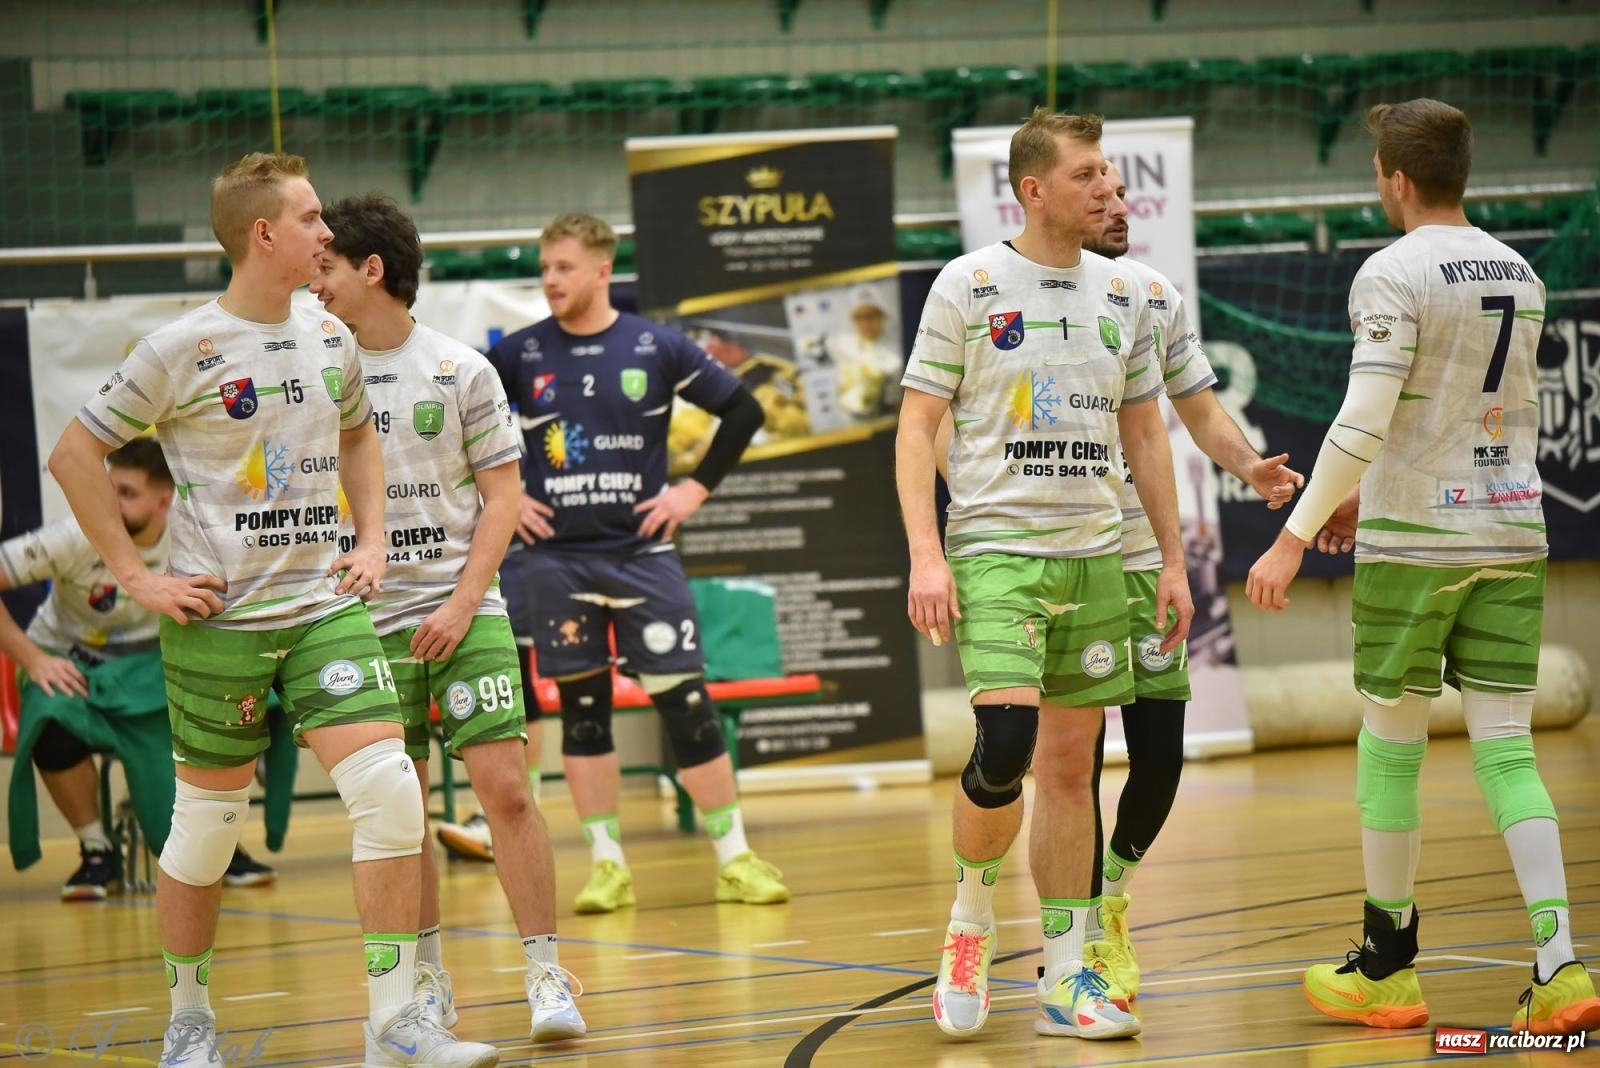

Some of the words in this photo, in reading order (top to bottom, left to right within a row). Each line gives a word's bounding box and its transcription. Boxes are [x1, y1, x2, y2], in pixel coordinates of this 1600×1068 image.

[1440, 260, 1535, 285] MYSZKOWSKI
[1059, 317, 1068, 340] 1
[1481, 295, 1515, 393] 7
[281, 379, 304, 404] 15
[582, 374, 595, 397] 2
[593, 434, 644, 450] GUARD
[1004, 440, 1067, 460] POMPY
[1474, 447, 1489, 458] MK
[1023, 464, 1054, 477] 605
[1059, 465, 1087, 477] 944
[1091, 466, 1109, 478] 146
[386, 483, 441, 499] GUARD
[544, 473, 596, 495] POMPY
[235, 508, 301, 531] POMPY
[258, 534, 290, 547] 605
[295, 530, 319, 544] 944
[415, 548, 442, 561] 146
[680, 619, 696, 651] 2
[327, 673, 358, 687] Jura
[369, 659, 396, 692] 15
[478, 674, 513, 712] 99
